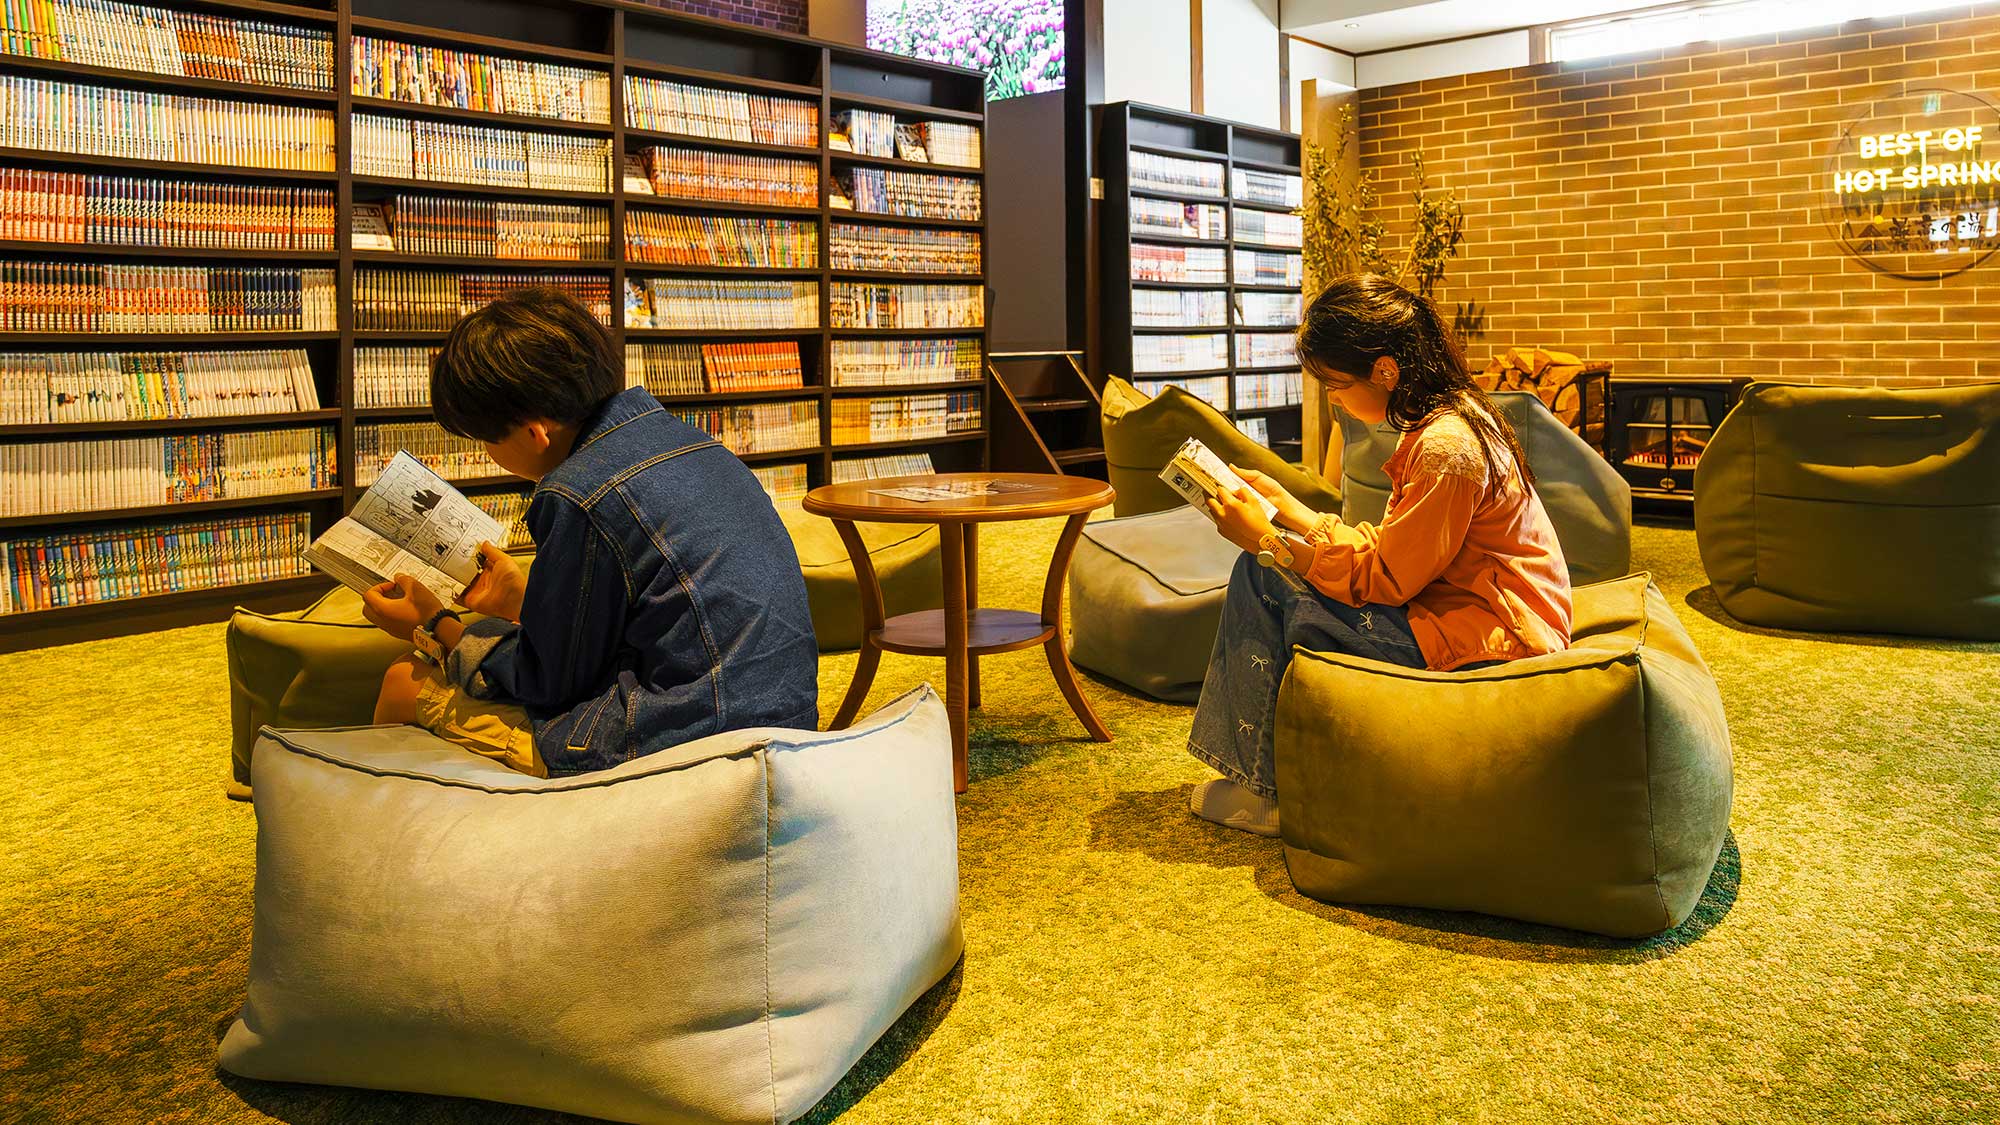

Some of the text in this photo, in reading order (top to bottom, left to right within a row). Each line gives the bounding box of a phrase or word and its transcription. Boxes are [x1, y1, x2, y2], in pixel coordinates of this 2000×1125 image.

[1860, 126, 1983, 159] BEST OF
[1834, 167, 1893, 195] HOT
